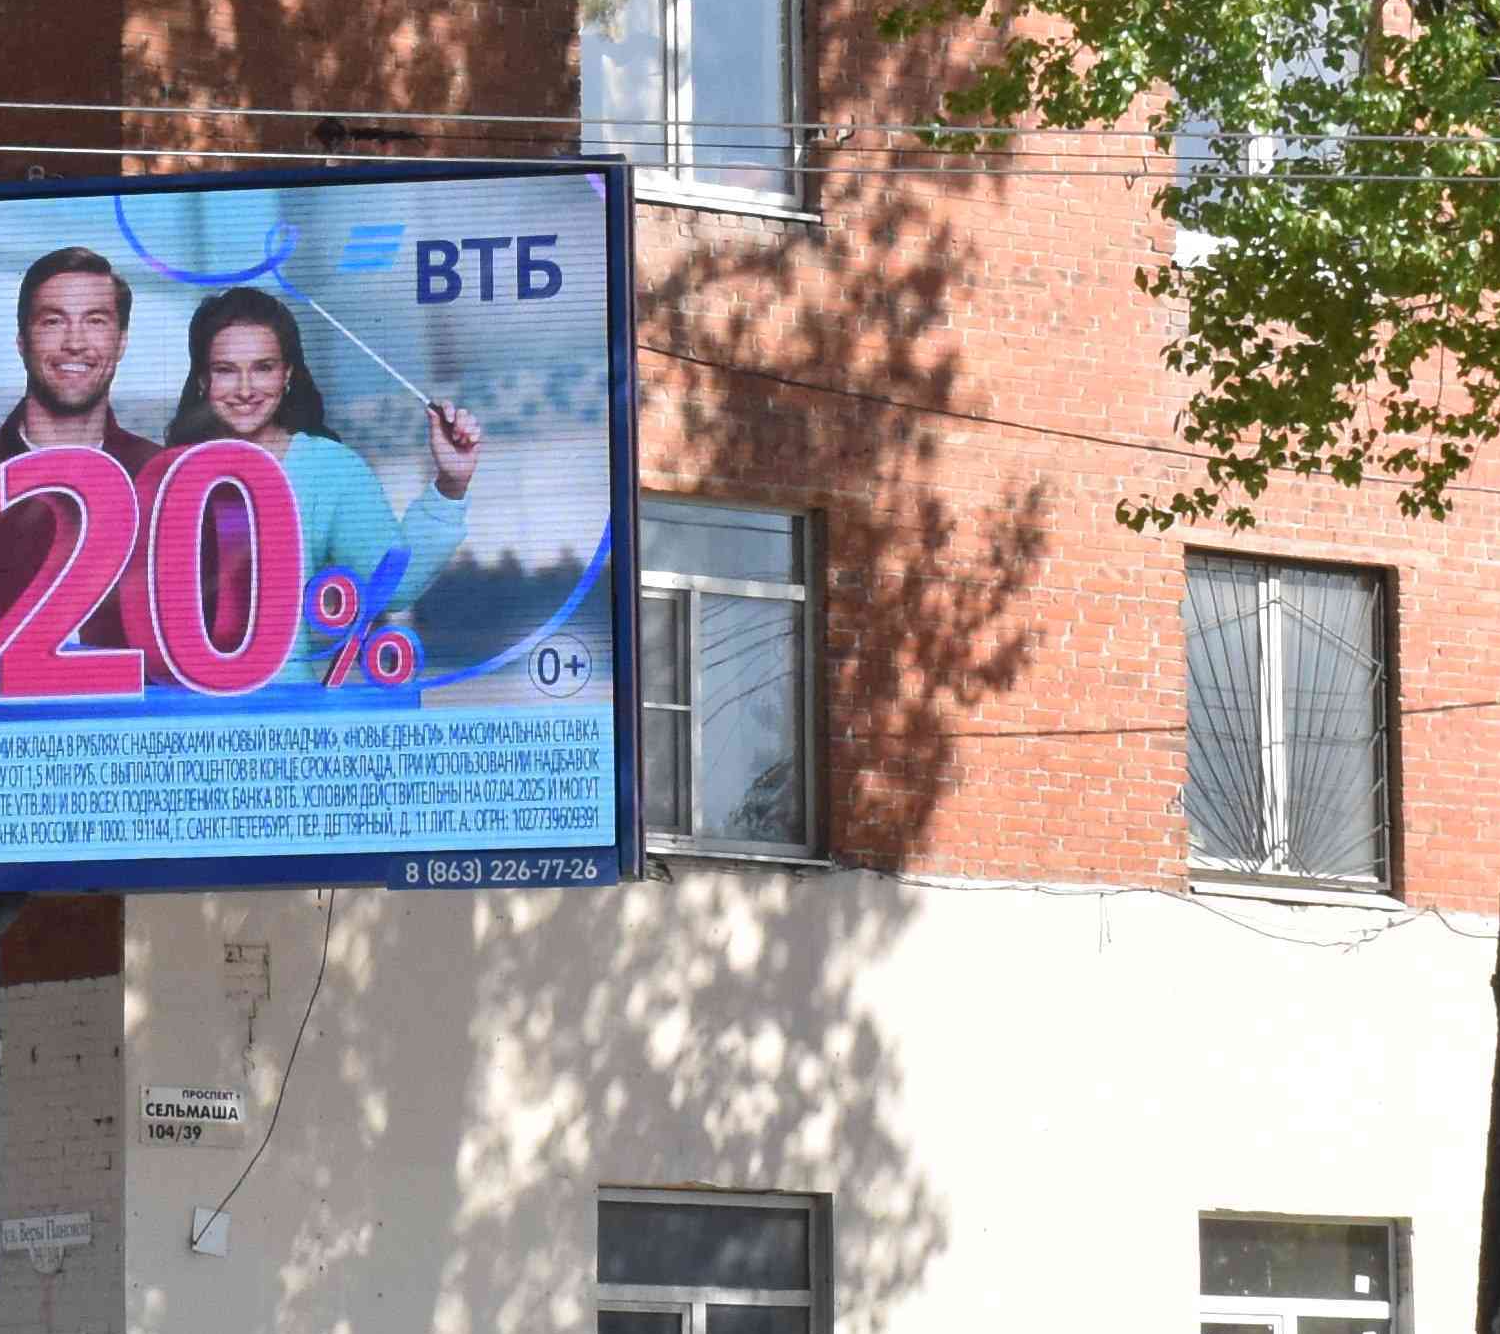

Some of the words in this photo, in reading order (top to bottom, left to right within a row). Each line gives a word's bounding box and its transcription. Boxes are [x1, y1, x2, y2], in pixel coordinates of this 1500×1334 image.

[417, 234, 562, 304] ВТБ
[537, 647, 586, 685] 0+
[406, 862, 420, 883] 8
[428, 858, 482, 885] (863)
[490, 858, 598, 881] 226-77-26
[182, 1089, 234, 1101] ПРОСПЕКТ
[145, 1103, 240, 1121] СЕЛЬМАША
[147, 1124, 202, 1143] 104/39
